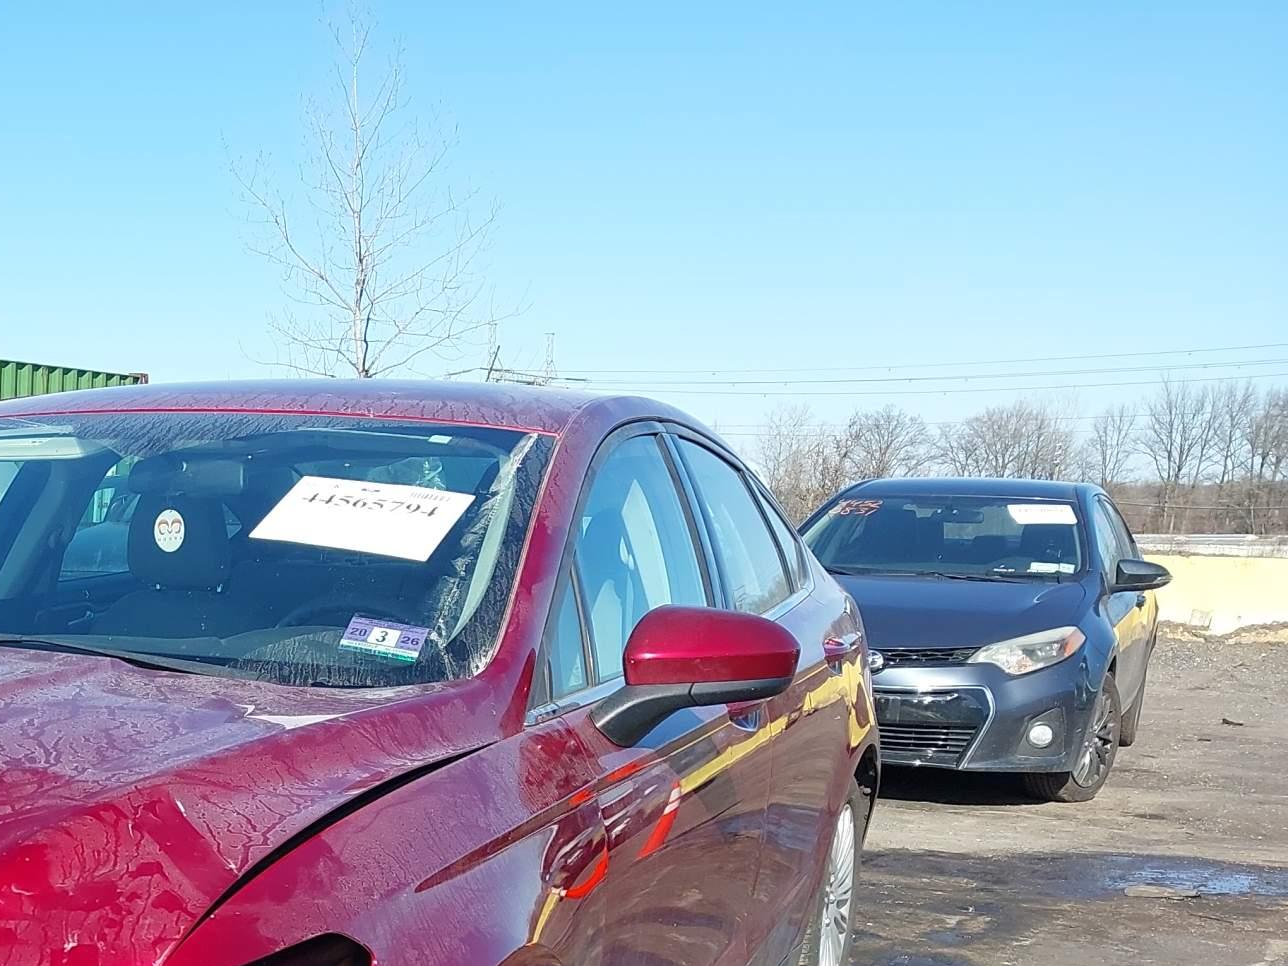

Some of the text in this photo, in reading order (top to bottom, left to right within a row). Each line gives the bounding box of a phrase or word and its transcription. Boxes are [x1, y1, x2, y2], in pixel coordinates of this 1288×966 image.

[302, 493, 439, 517] 44565794
[350, 627, 420, 646] 20 3 26
